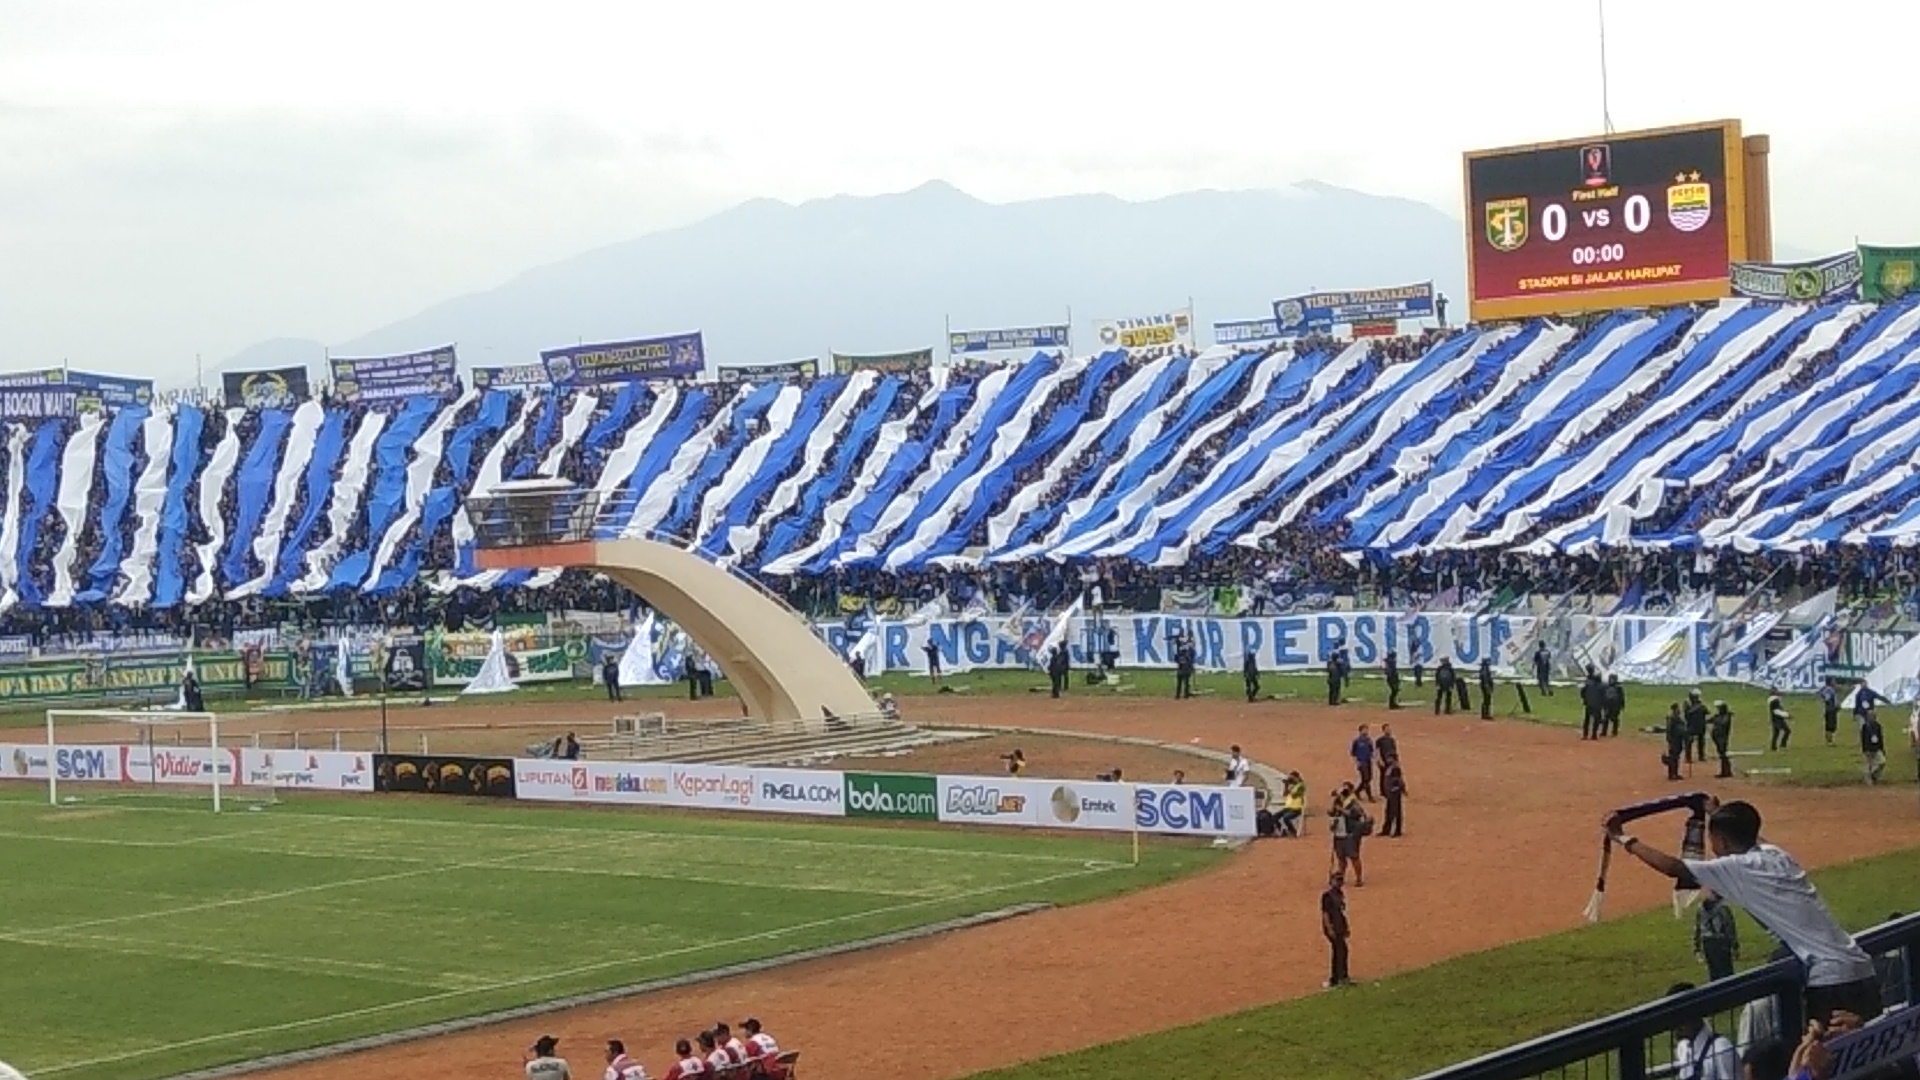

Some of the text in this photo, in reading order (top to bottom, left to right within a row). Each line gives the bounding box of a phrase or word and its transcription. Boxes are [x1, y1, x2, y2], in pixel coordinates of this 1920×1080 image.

[1542, 195, 1651, 241] 0 VS 0
[1572, 243, 1624, 265] 00:00
[1518, 275, 1569, 290] STADION
[1585, 269, 1624, 285] JALAK
[1626, 264, 1682, 280] HARUPAT
[57, 749, 106, 778] SCM
[156, 752, 202, 778] Vidio
[673, 772, 754, 804] KapanLagi
[762, 782, 840, 804] FIMELA.COM
[848, 780, 936, 814] bola.com
[1081, 797, 1117, 813] Emtek
[1136, 789, 1224, 830] SCM
